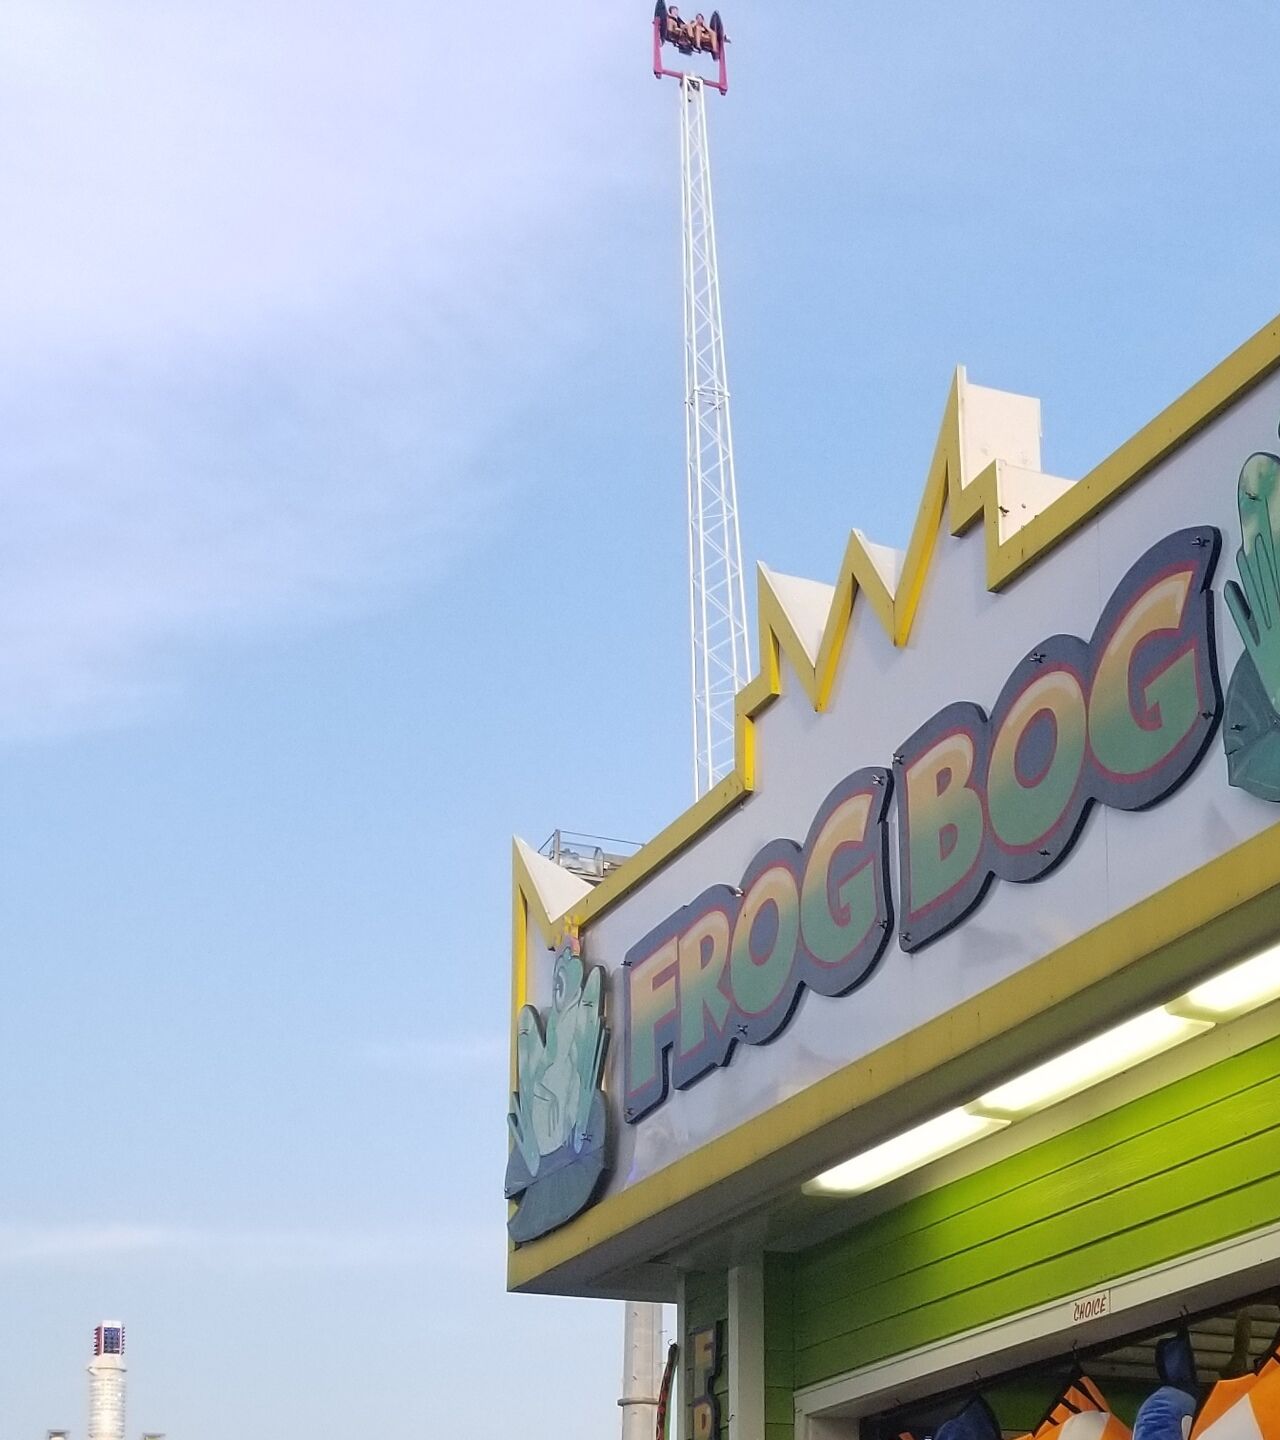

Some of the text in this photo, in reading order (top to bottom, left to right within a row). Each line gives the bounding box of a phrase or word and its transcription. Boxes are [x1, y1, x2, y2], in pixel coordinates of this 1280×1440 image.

[628, 561, 1202, 1096] FROG BOG
[1073, 1295, 1107, 1322] CHOICE
